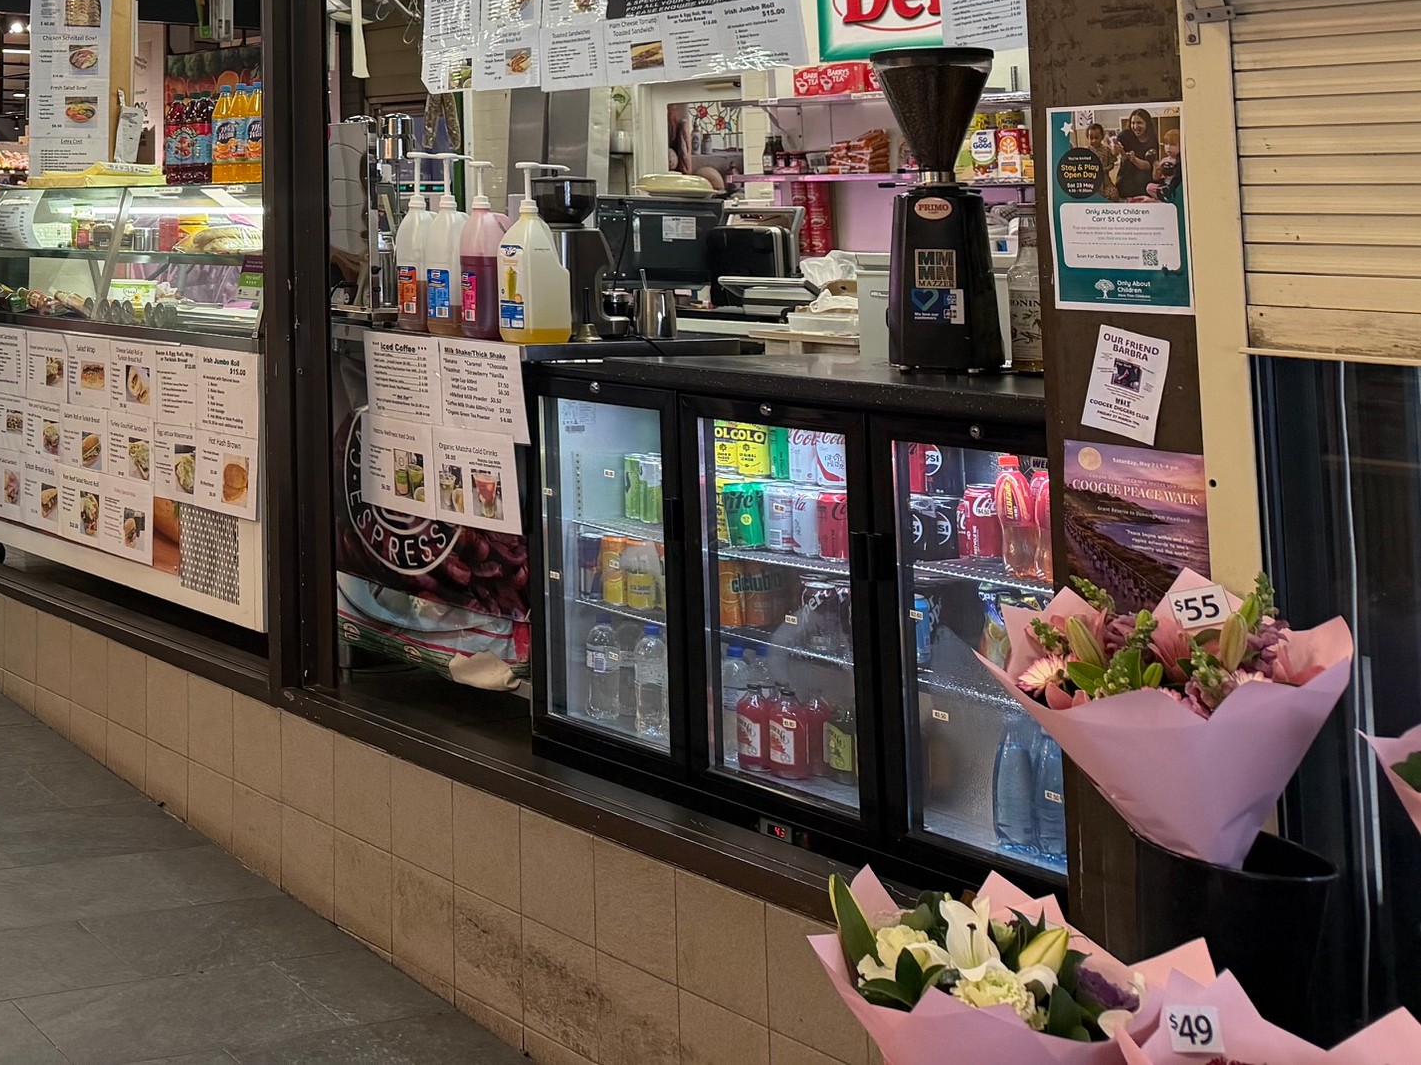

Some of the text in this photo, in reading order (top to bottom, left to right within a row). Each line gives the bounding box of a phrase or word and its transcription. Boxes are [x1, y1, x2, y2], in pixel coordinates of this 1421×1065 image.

[1061, 164, 1076, 173] Stay
[1084, 164, 1099, 173] Play
[1064, 171, 1082, 180] Open
[1103, 333, 1160, 356] OUR FRIEND
[1112, 344, 1149, 362] BARBRA
[203, 356, 240, 367] Irish Jumbo Roll
[230, 367, 246, 377] $15.00
[1072, 478, 1199, 506] COOGEE PEACE WALK
[1173, 593, 1221, 623] $55
[1168, 1012, 1215, 1046] $49
